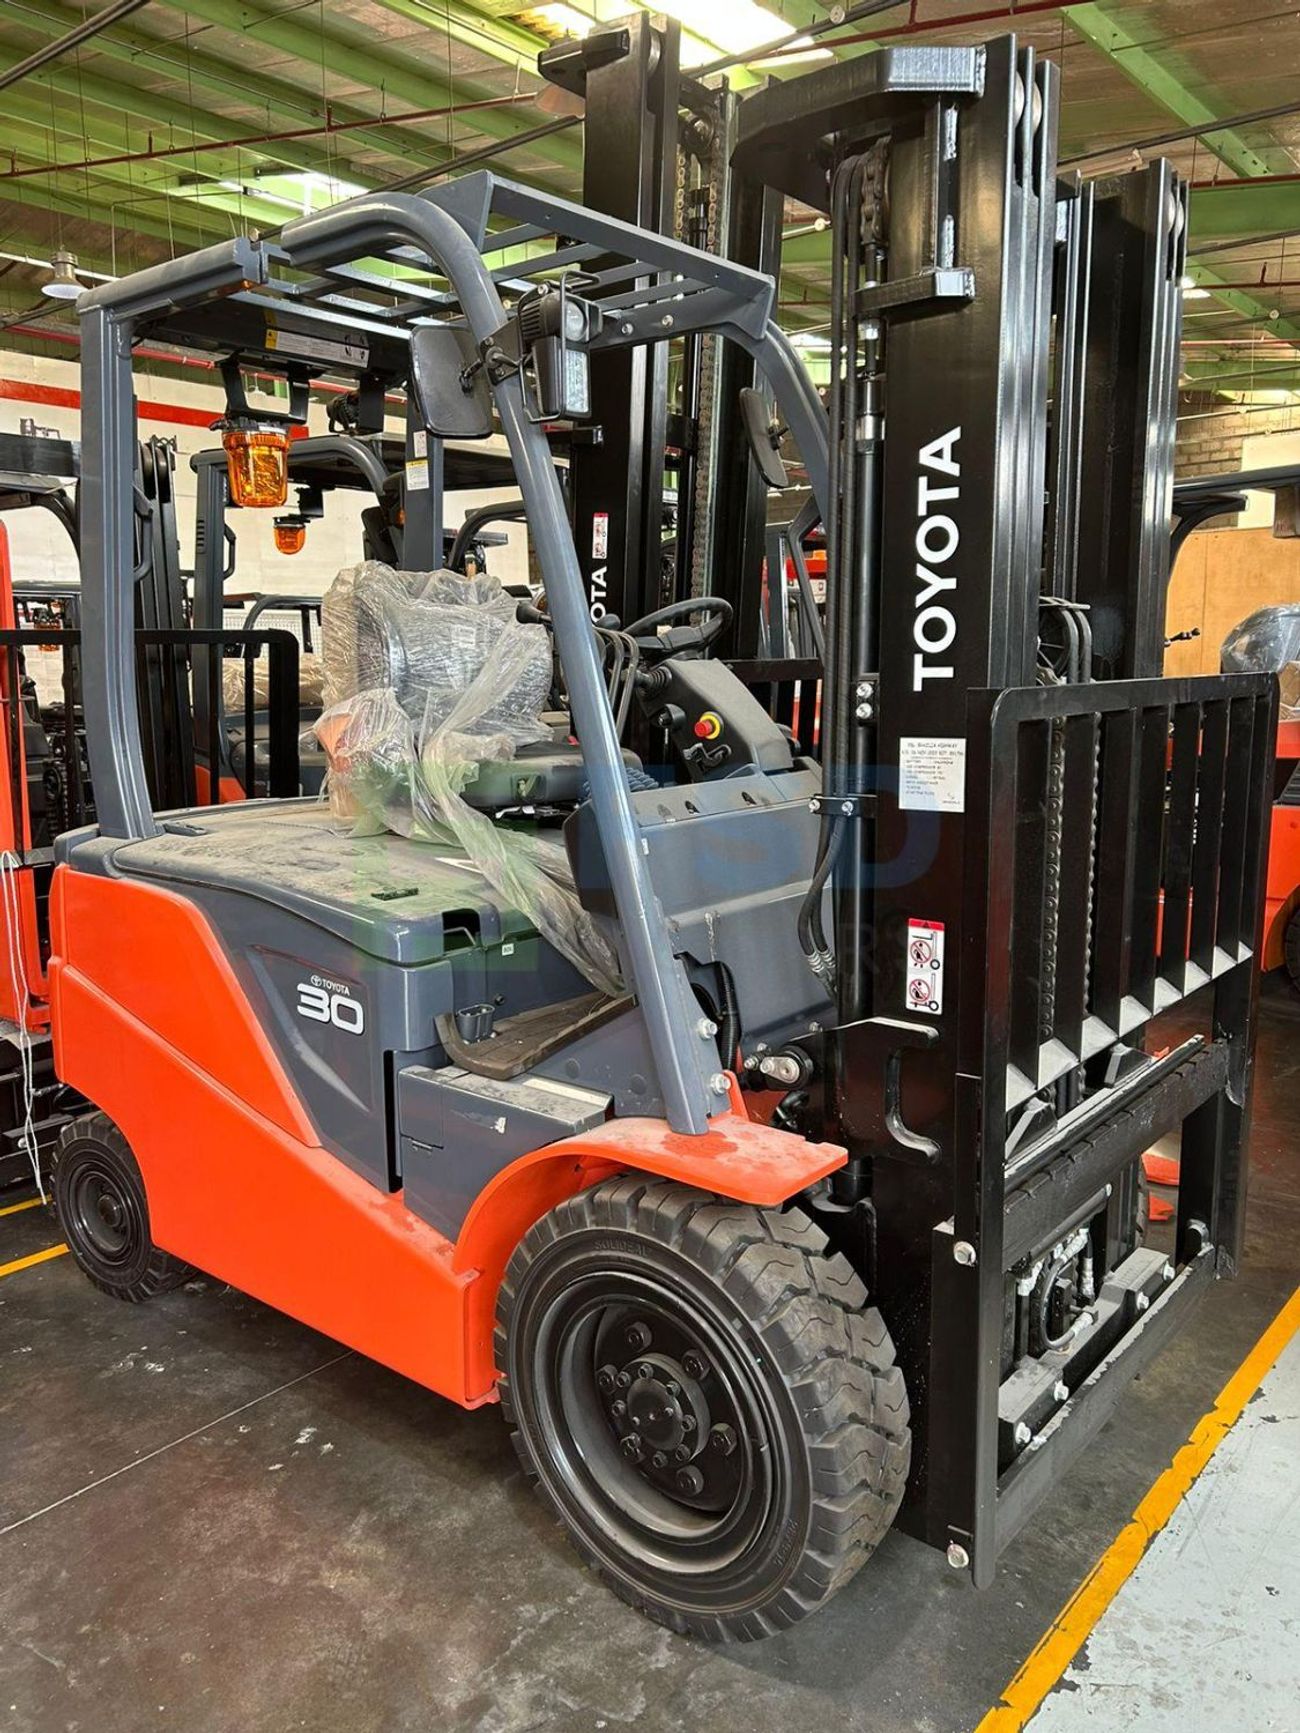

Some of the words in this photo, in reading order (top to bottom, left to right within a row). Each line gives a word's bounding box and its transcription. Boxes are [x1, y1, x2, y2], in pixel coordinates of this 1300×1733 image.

[913, 426, 961, 692] TOYOTA
[590, 566, 608, 624] OTA
[297, 983, 364, 1035] 30
[321, 978, 350, 996] TOYOTA
